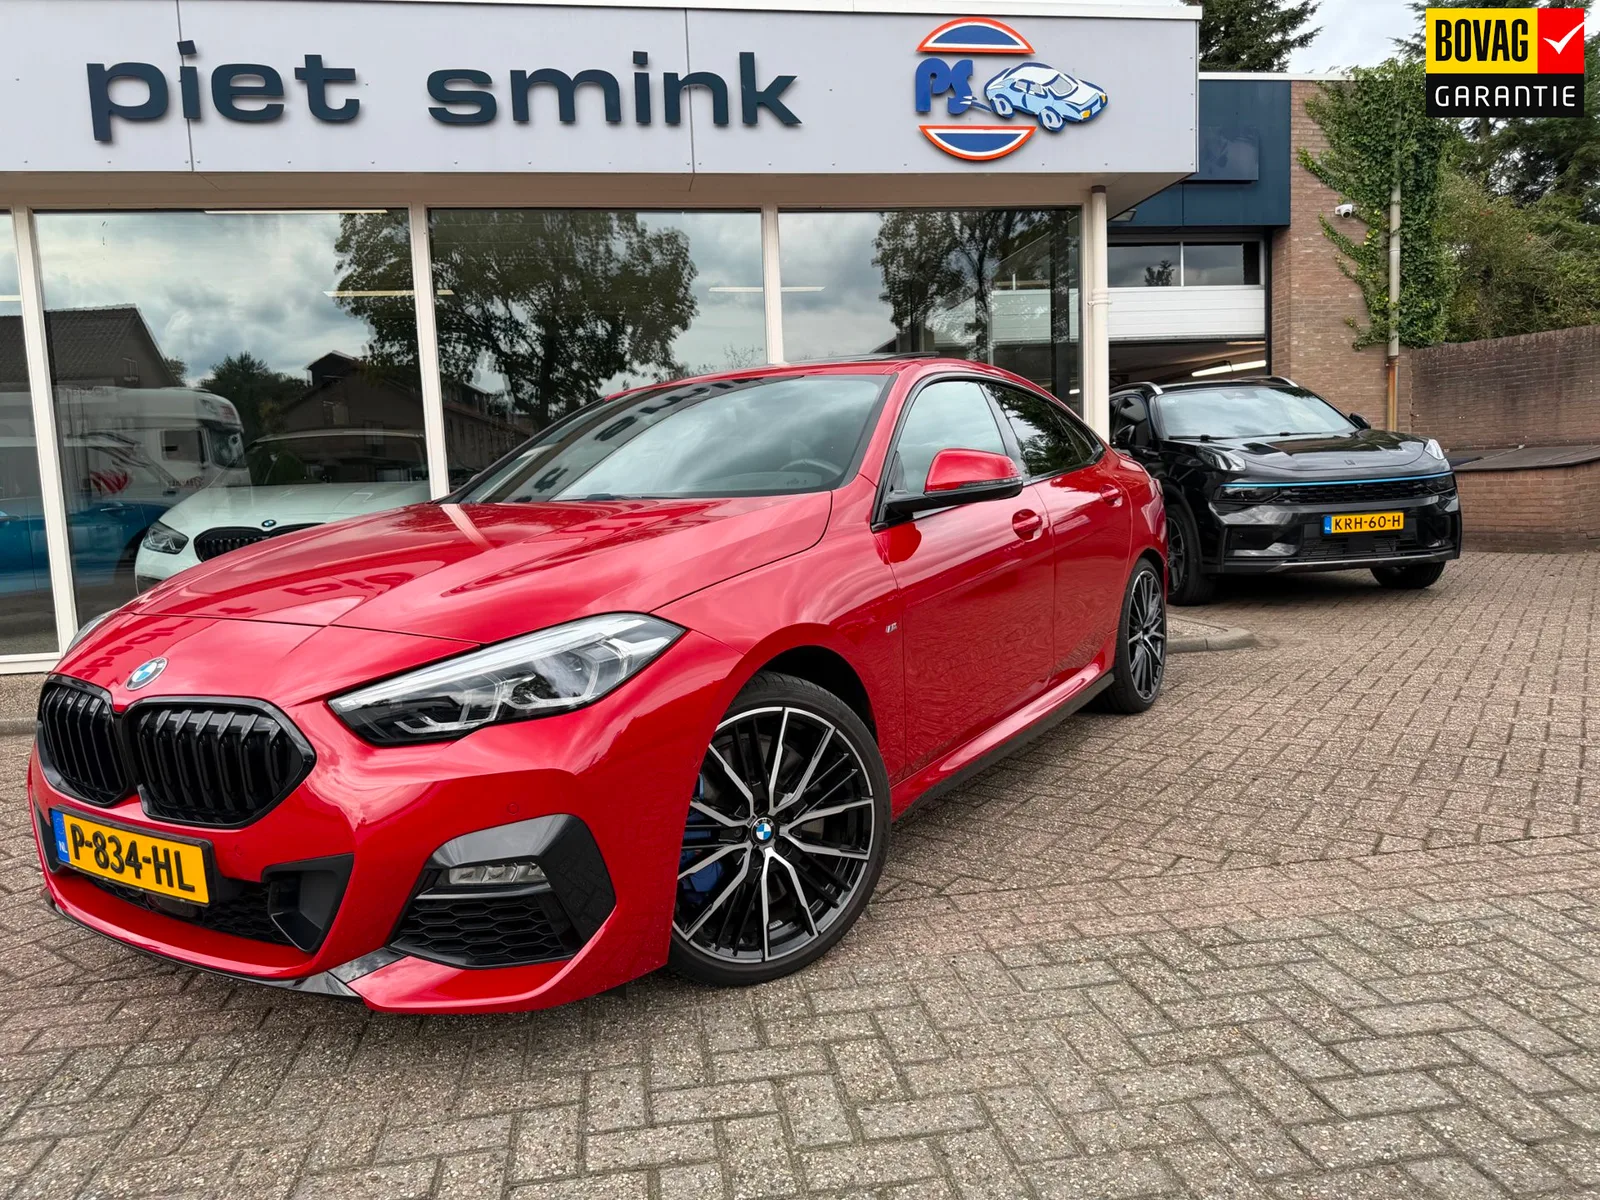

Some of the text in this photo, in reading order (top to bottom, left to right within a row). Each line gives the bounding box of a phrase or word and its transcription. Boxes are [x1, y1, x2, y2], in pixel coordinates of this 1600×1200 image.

[87, 40, 802, 142] piet smink
[1334, 515, 1401, 531] KRH-60-H
[58, 823, 195, 893] NL P-834-HL
